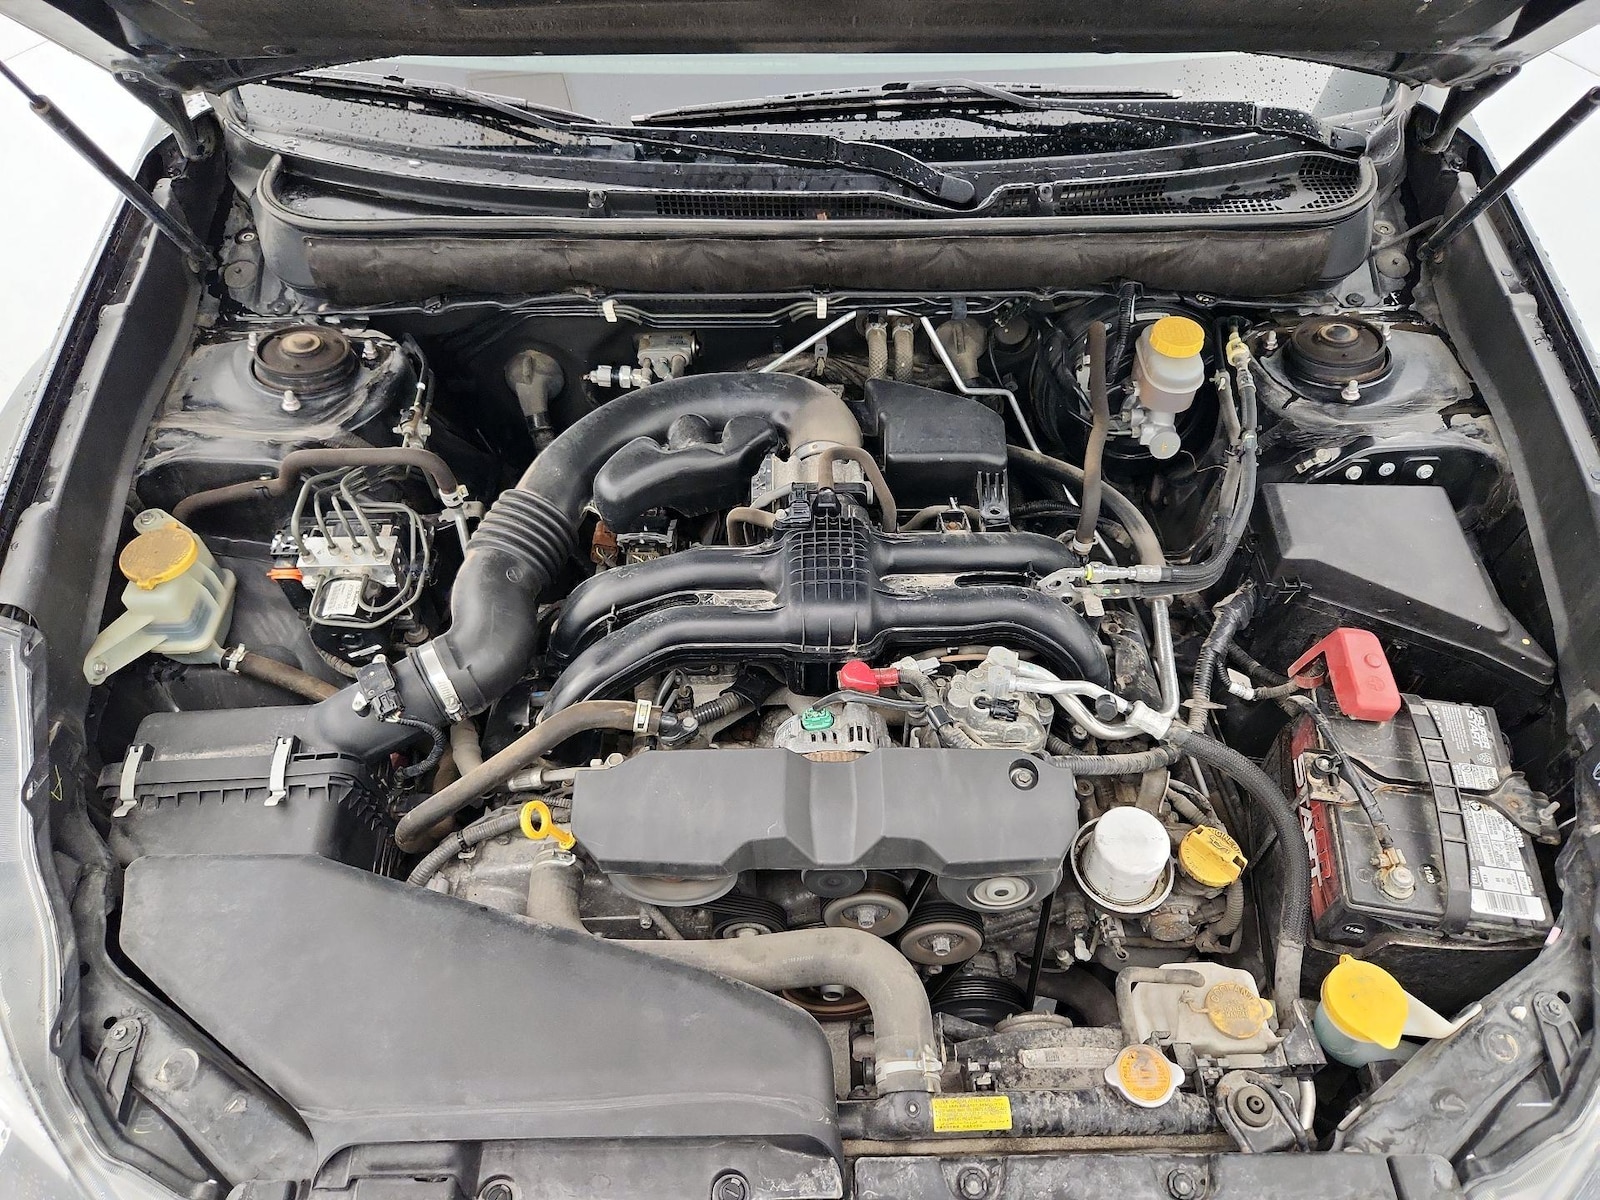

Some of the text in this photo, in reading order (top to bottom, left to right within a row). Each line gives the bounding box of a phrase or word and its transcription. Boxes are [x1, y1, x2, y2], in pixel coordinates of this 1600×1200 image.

[1465, 708, 1481, 747] START
[1477, 714, 1491, 750] SUPER
[1293, 753, 1323, 887] START
[1423, 865, 1436, 884] 11/20
[1210, 984, 1255, 1003] COOLANT
